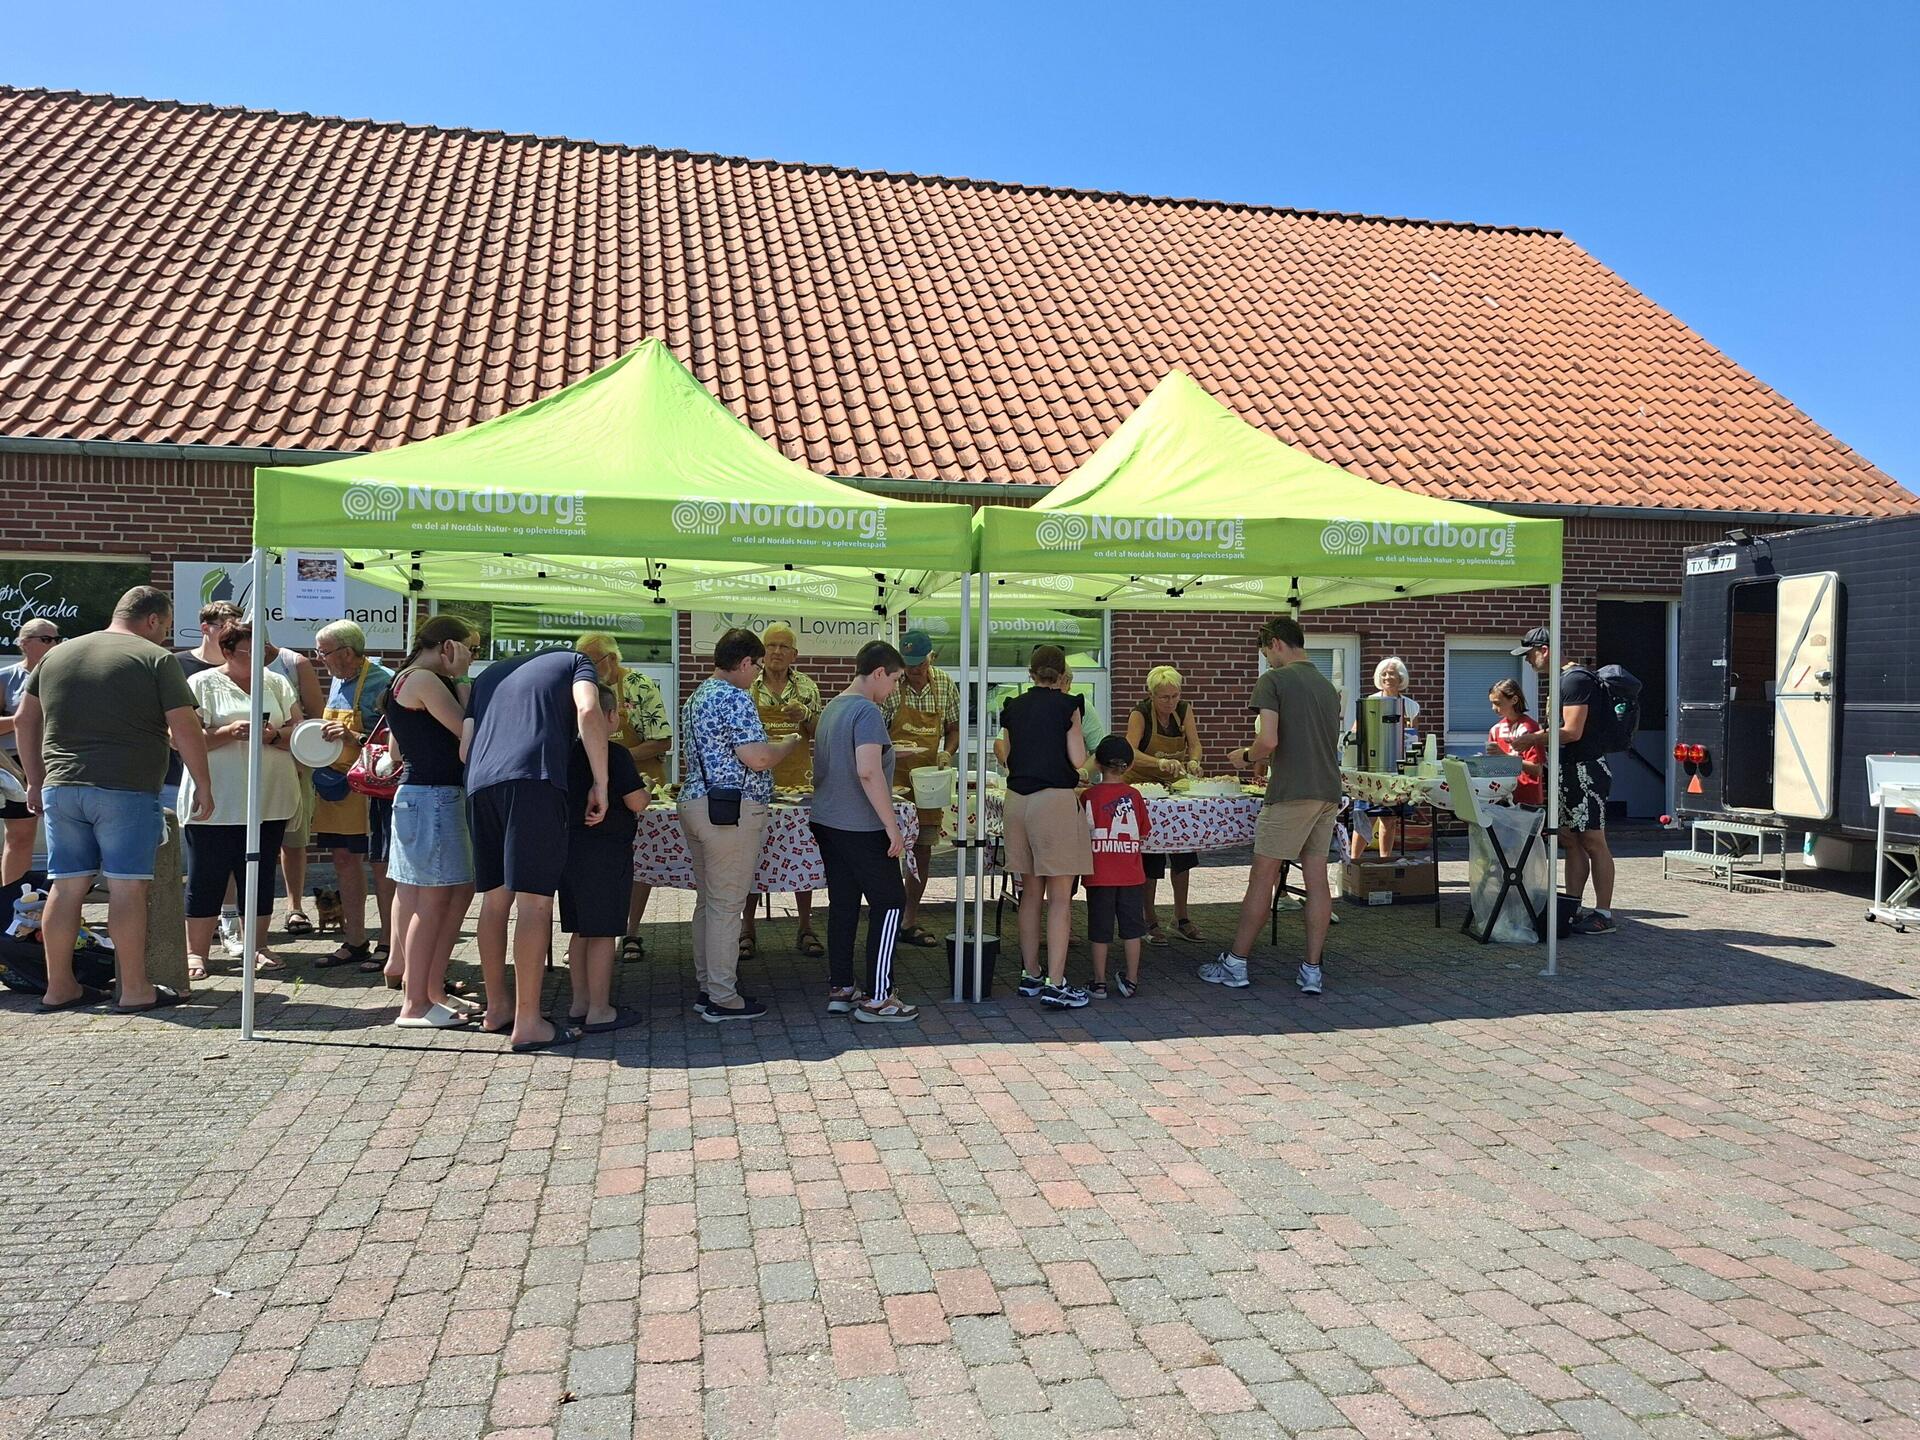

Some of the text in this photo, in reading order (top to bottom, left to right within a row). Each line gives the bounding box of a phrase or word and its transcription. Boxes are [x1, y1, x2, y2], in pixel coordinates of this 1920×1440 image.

[408, 484, 575, 525] Nordborg
[424, 522, 439, 531] del
[440, 522, 450, 531] af
[451, 523, 483, 533] Nordals
[513, 527, 524, 536] og
[526, 526, 587, 536] oplevelsespark
[729, 499, 877, 539] Nordborg
[1092, 513, 1236, 550] Nordborg
[743, 536, 756, 544] del
[757, 536, 766, 544] af
[767, 537, 795, 545] Nordals
[832, 540, 887, 549] oplevelsespark
[1372, 520, 1507, 557] Nordborg
[1505, 520, 1517, 558] Handel
[1191, 552, 1245, 560] oplevelsespark
[1691, 560, 1704, 572] TX
[498, 639, 529, 652] TLF.
[1085, 797, 1140, 841] LA
[1092, 840, 1140, 853] UMMER
